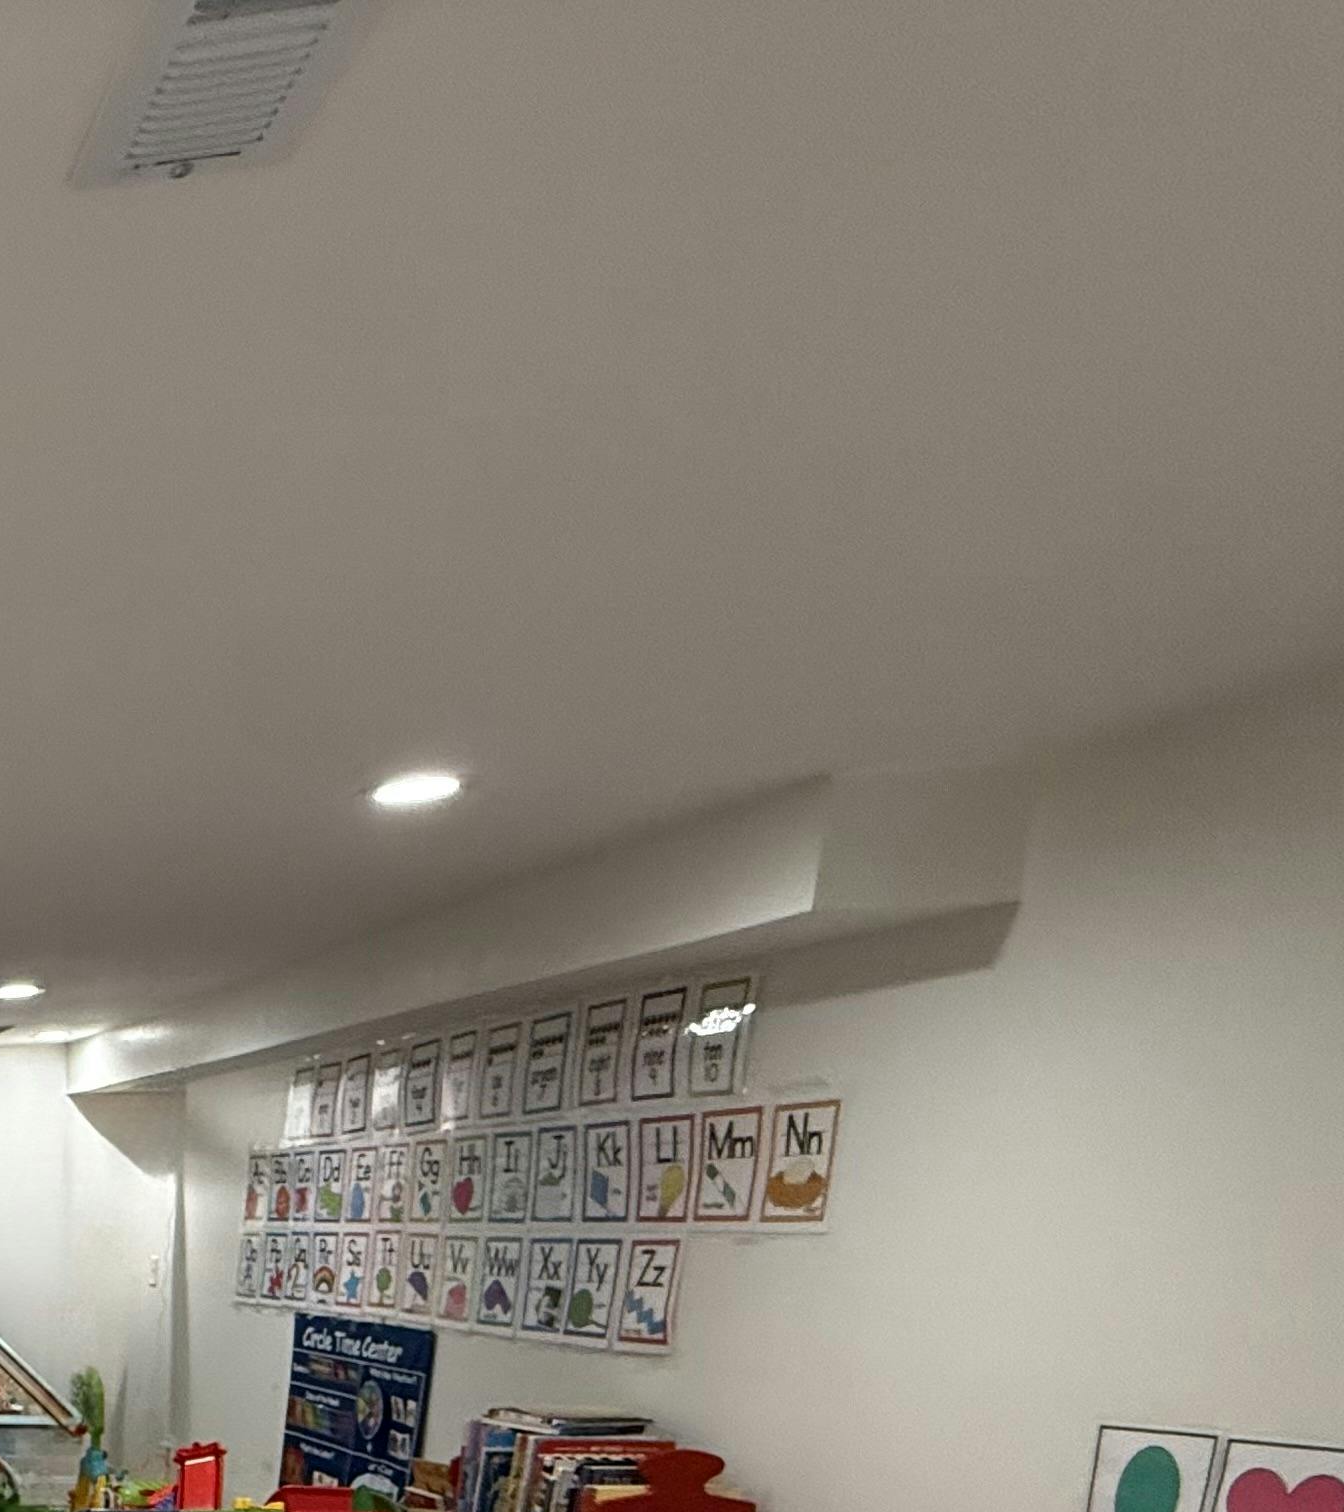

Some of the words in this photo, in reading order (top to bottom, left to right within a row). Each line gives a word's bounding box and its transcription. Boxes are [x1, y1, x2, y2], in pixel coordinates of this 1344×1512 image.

[596, 1131, 622, 1167] Kk
[656, 1125, 678, 1164] Ll
[708, 1120, 754, 1160] Mm
[785, 1112, 823, 1158] Nn
[323, 1155, 341, 1183] Dd
[356, 1153, 372, 1182] Ee
[419, 1146, 440, 1186] Gg
[459, 1143, 482, 1176] Hh
[549, 1134, 568, 1180] Jj
[450, 1244, 469, 1274] Vv
[539, 1245, 562, 1281] Xx
[586, 1247, 609, 1292] Yy
[635, 1249, 667, 1288] Zz
[302, 1326, 333, 1352] Circle
[334, 1330, 362, 1357] Time
[361, 1335, 404, 1364] Center
